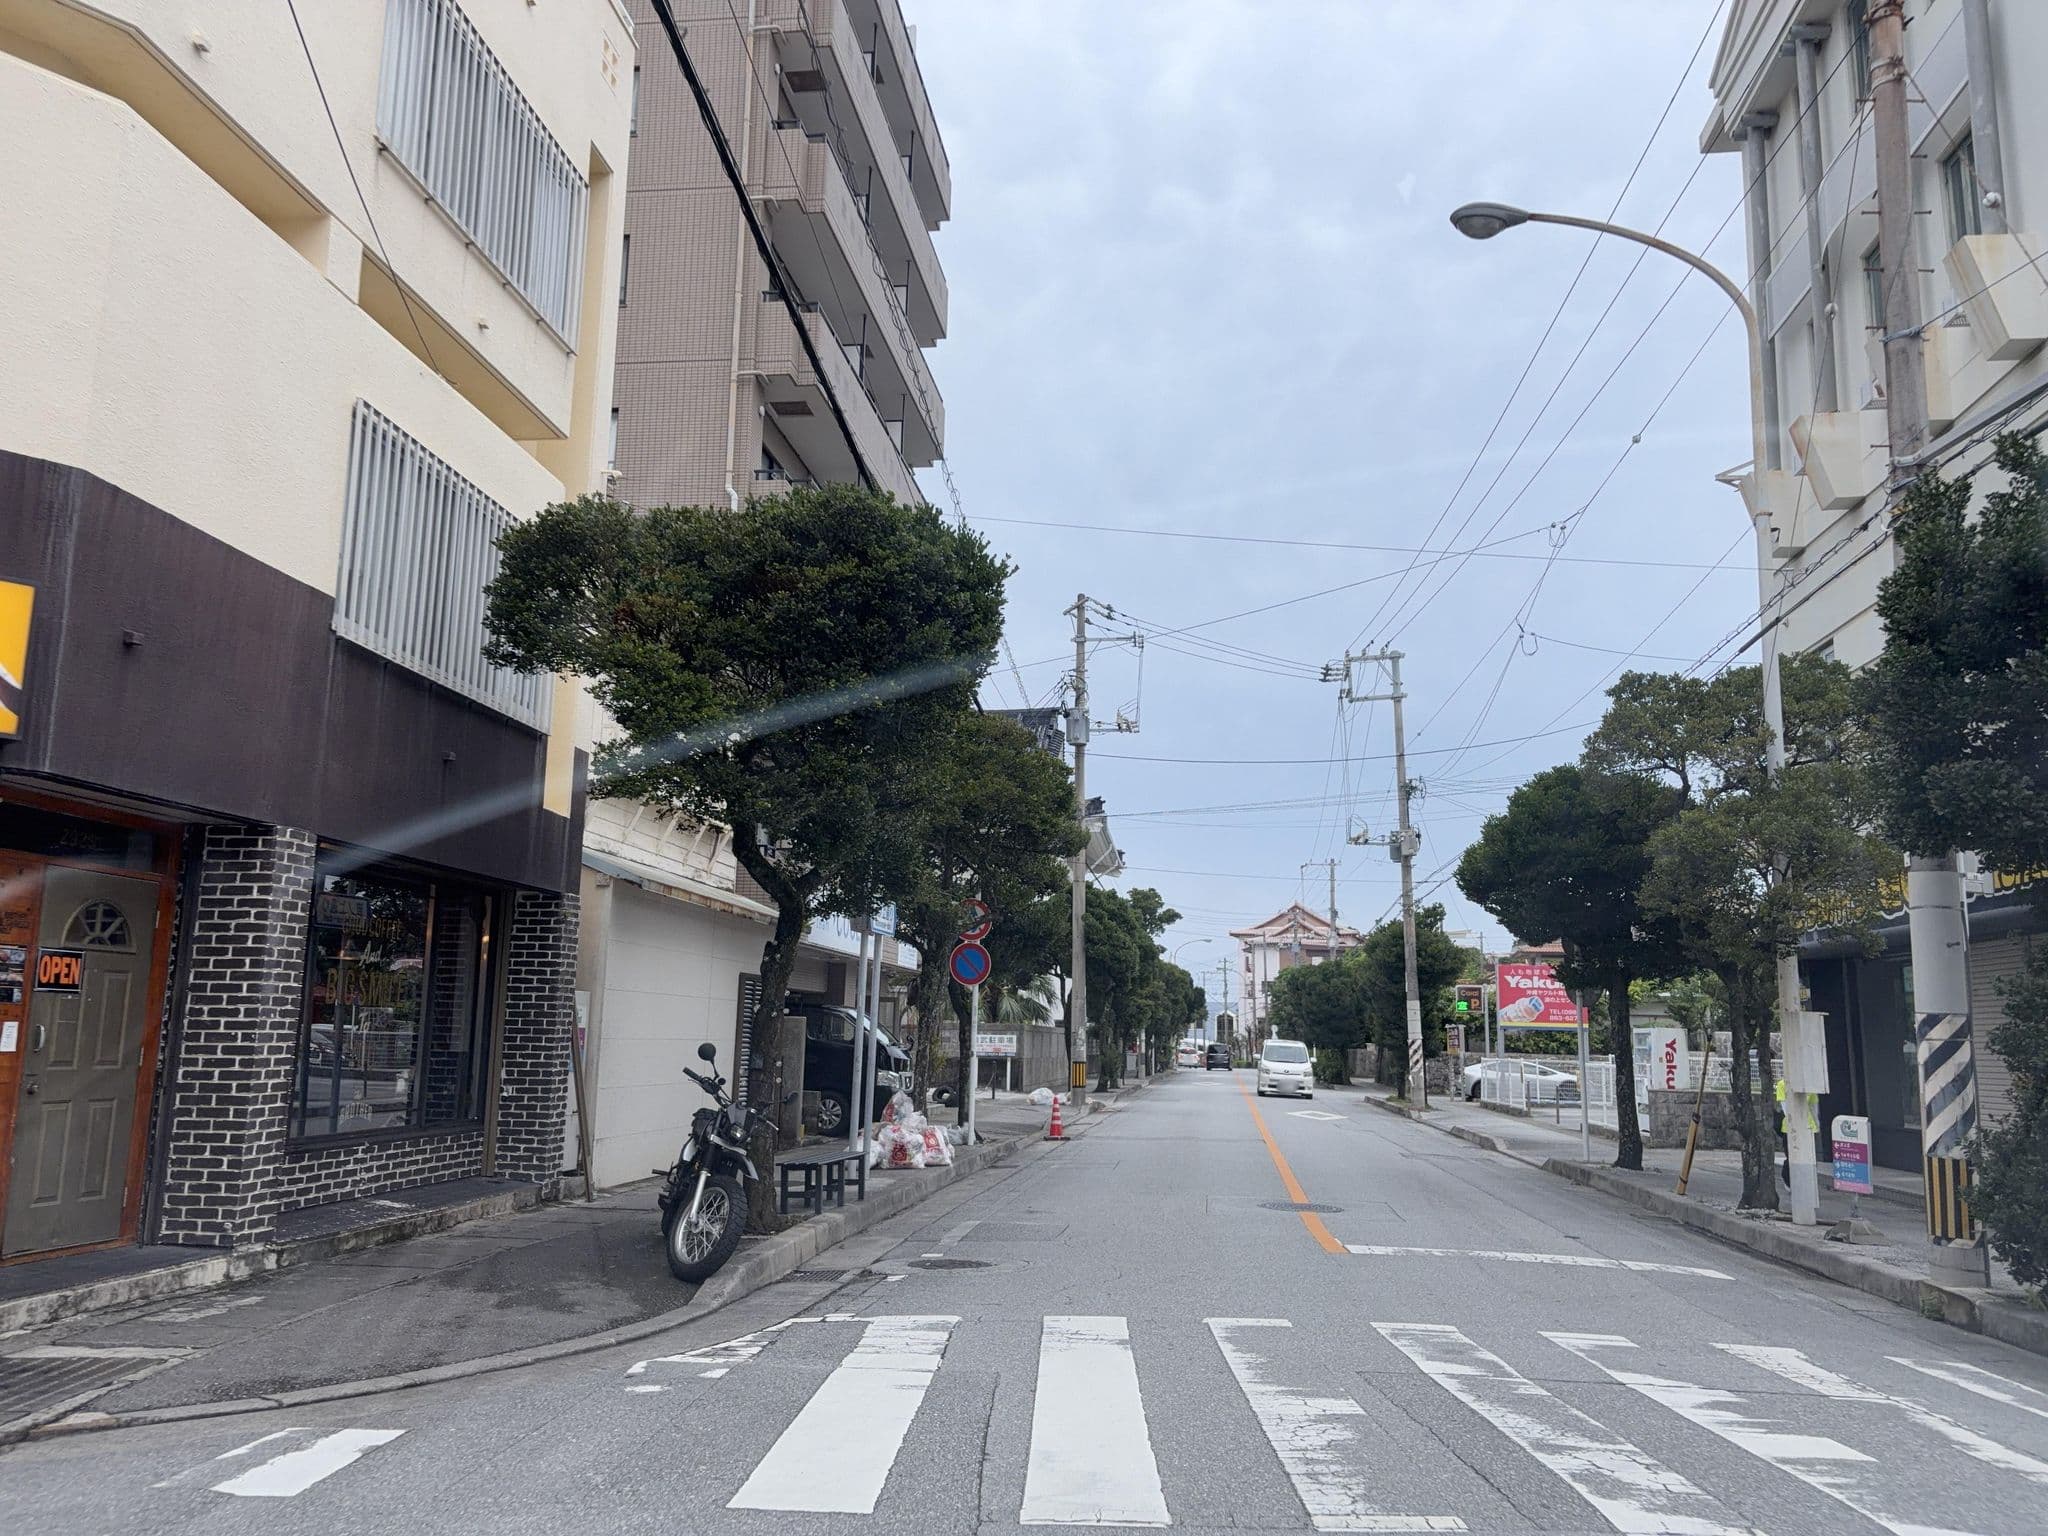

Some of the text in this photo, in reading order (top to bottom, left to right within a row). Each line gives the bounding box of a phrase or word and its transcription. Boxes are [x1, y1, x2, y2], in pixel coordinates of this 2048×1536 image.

[39, 954, 81, 985] OPEN
[1504, 976, 1566, 989] Yaku
[1471, 999, 1480, 1010] P
[1665, 1038, 1677, 1090] Yaku
